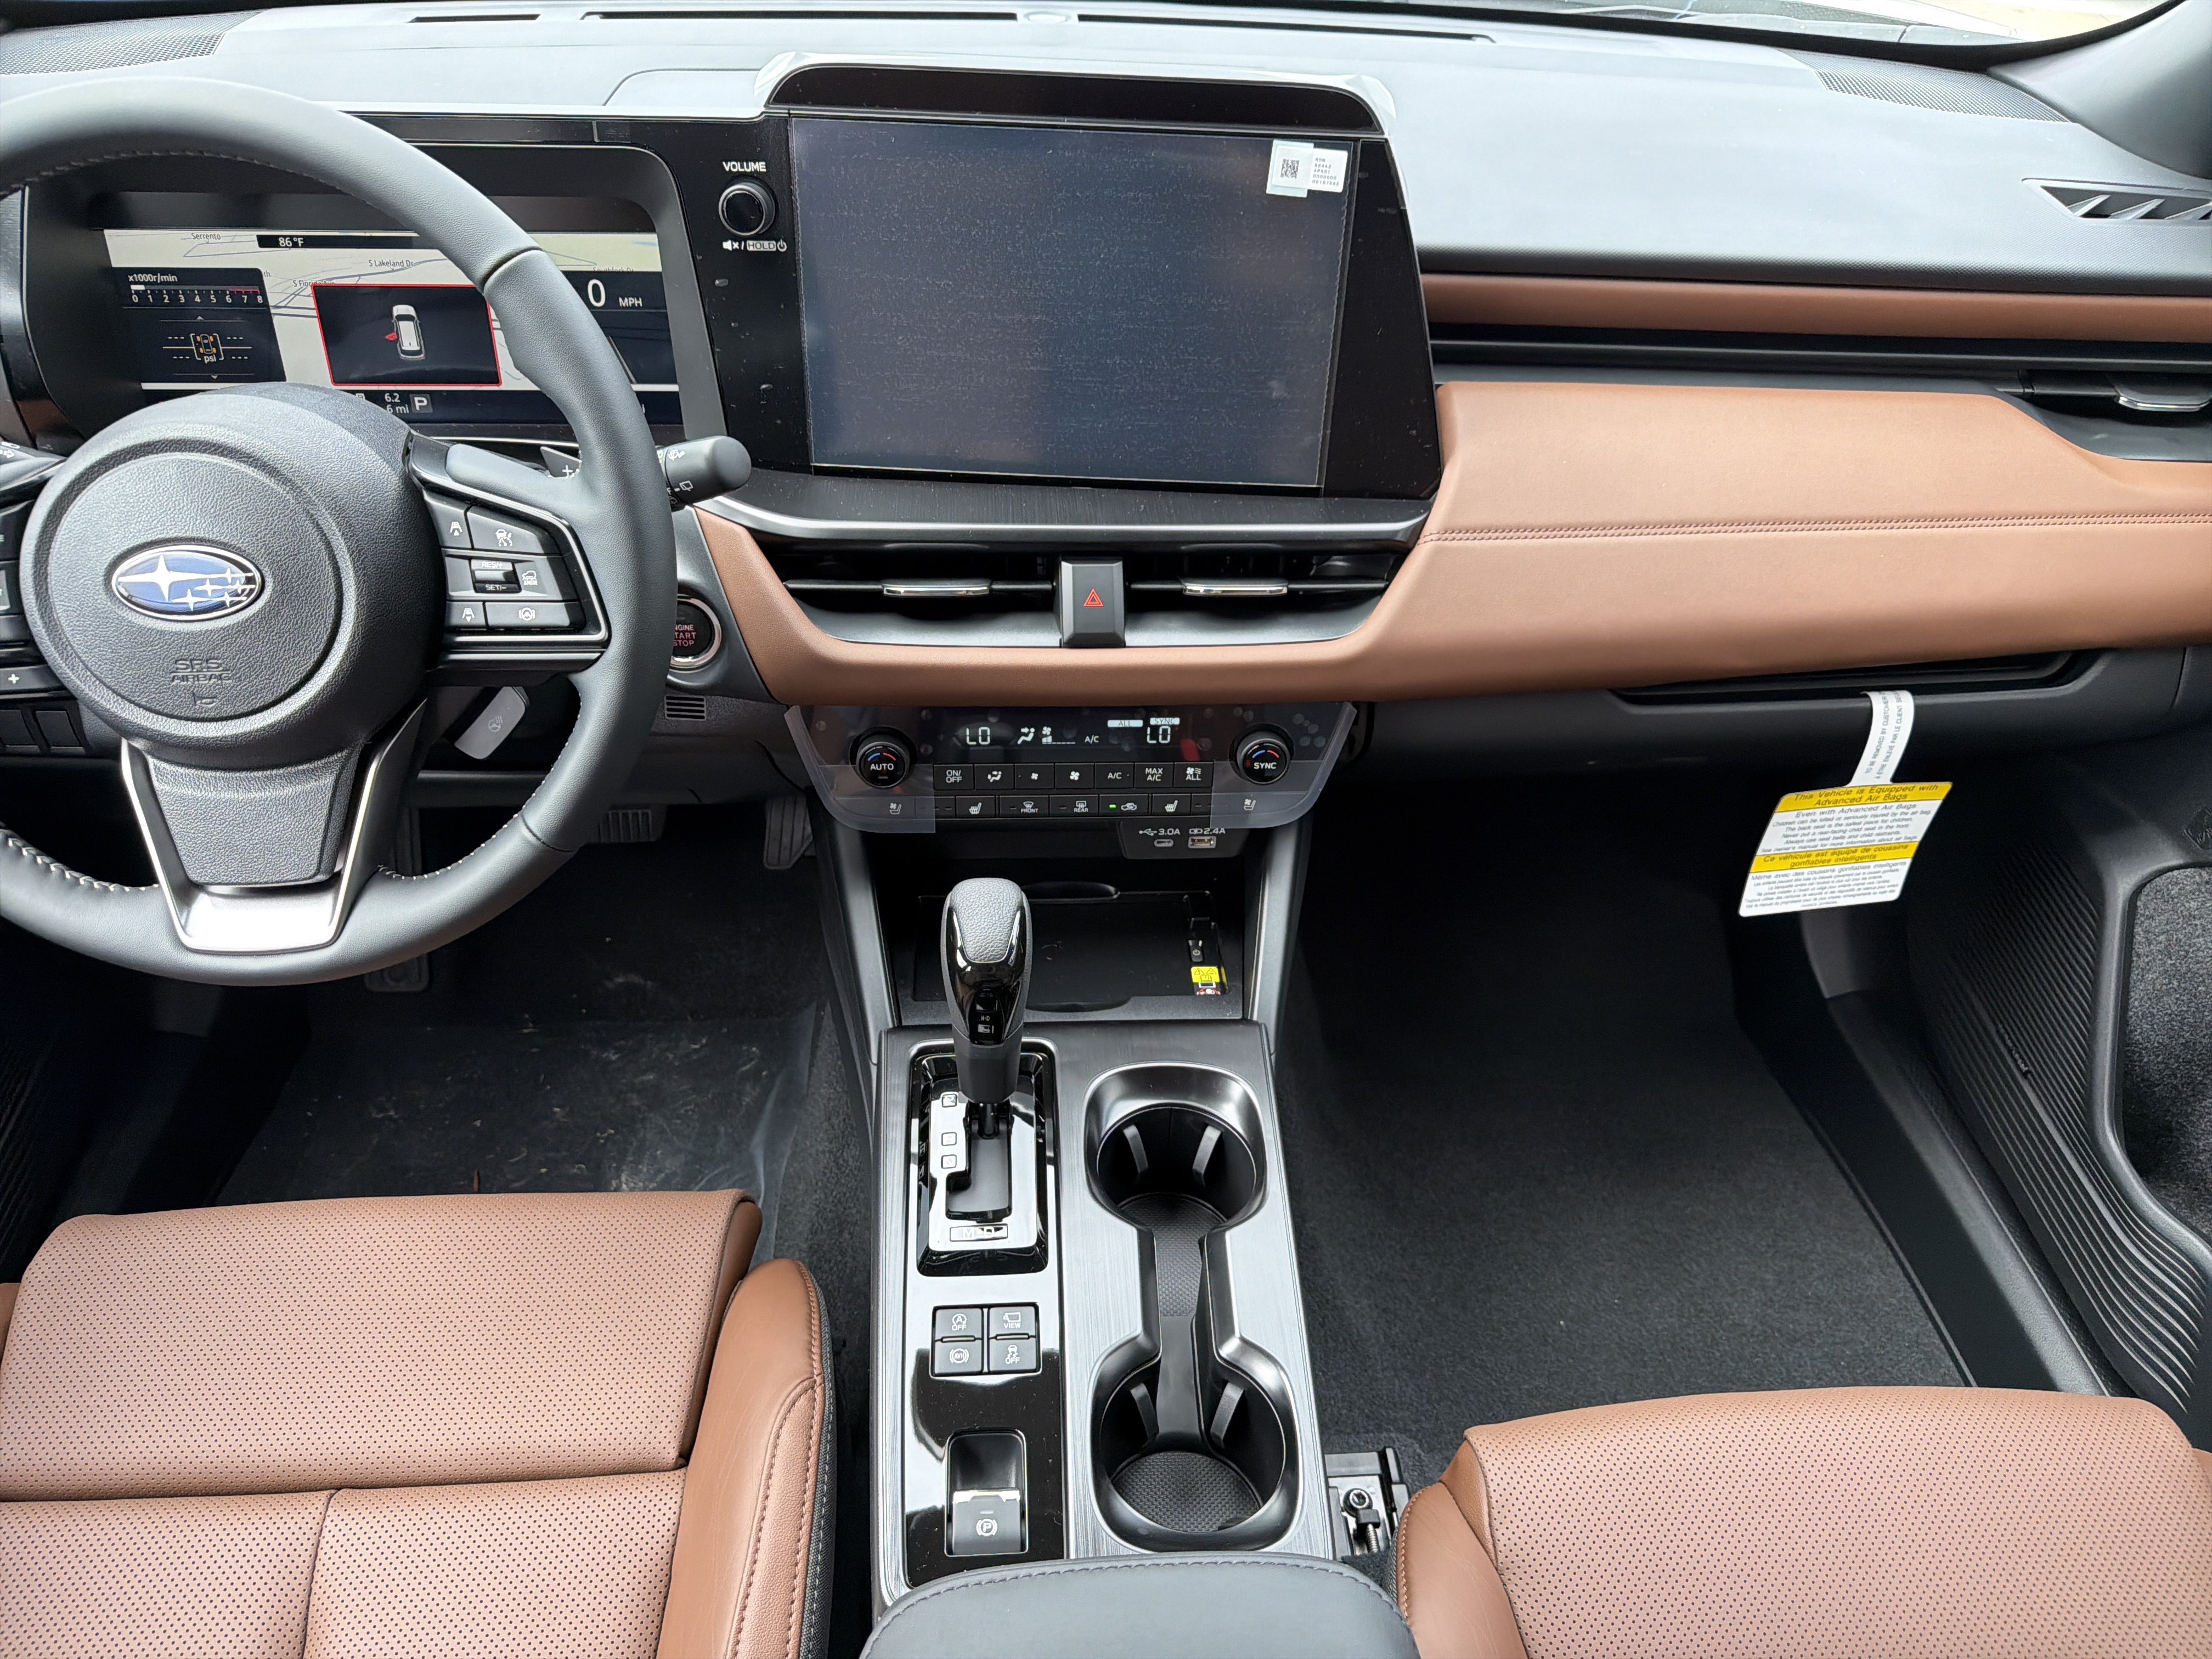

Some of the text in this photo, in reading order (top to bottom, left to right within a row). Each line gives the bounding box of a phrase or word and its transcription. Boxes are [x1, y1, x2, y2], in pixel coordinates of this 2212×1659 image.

[723, 161, 766, 172] VOLUME
[128, 273, 178, 283] x1000r/min
[587, 279, 642, 307] 0 MPH
[204, 355, 217, 363] psi
[385, 393, 400, 402] 6.2
[414, 397, 427, 411] P
[386, 404, 409, 414] 6 mi
[171, 674, 232, 684] AIRBAG
[966, 727, 990, 745] LO
[1147, 726, 1171, 743] LO
[1085, 735, 1099, 744] A/C
[1254, 761, 1277, 770] SYNC
[1869, 785, 1916, 794] Equipped
[1814, 796, 1862, 805] Advanced
[1204, 827, 1226, 835] 2.4A
[983, 1523, 992, 1531] P
